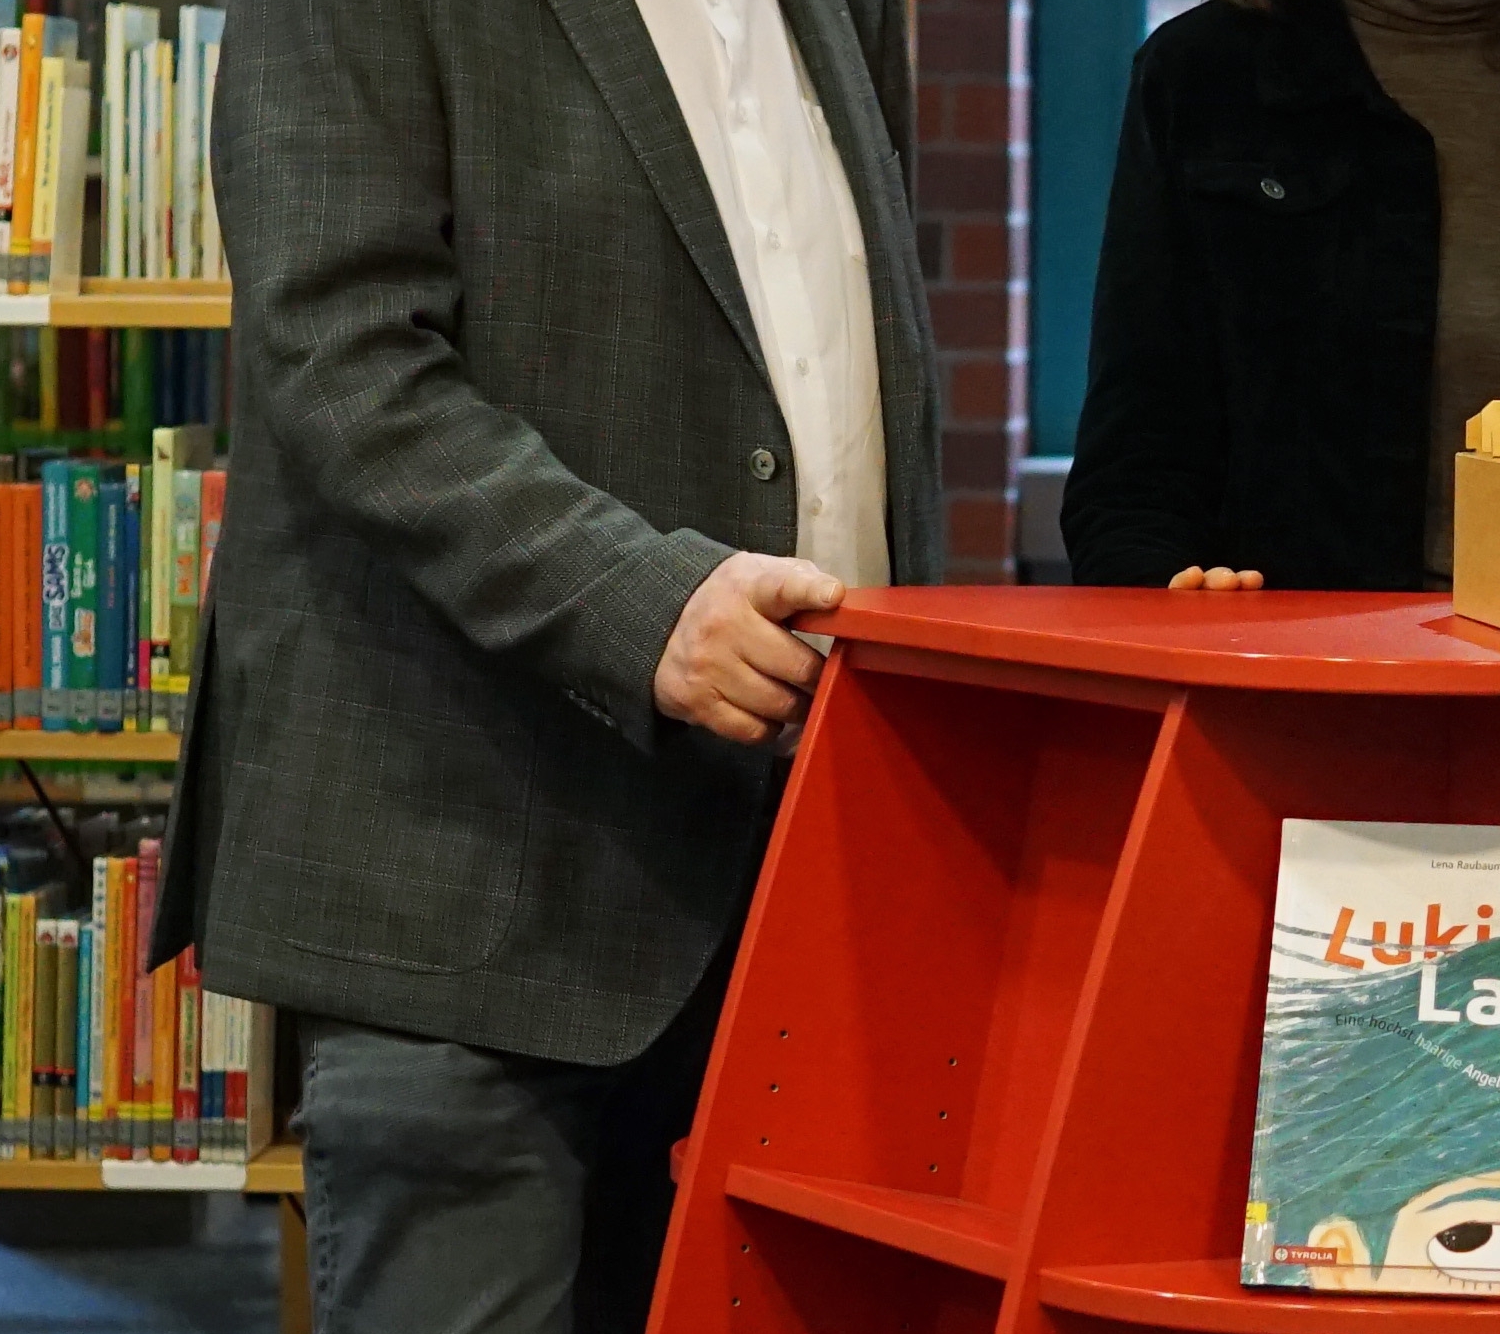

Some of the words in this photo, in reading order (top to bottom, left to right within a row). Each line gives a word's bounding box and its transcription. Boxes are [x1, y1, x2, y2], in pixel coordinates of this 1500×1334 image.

[1431, 858, 1454, 871] Lena
[1323, 902, 1495, 971] Luki
[1335, 1013, 1365, 1027] Eine
[1414, 1031, 1463, 1070] haarige
[1290, 1249, 1334, 1262] TYROLIA
